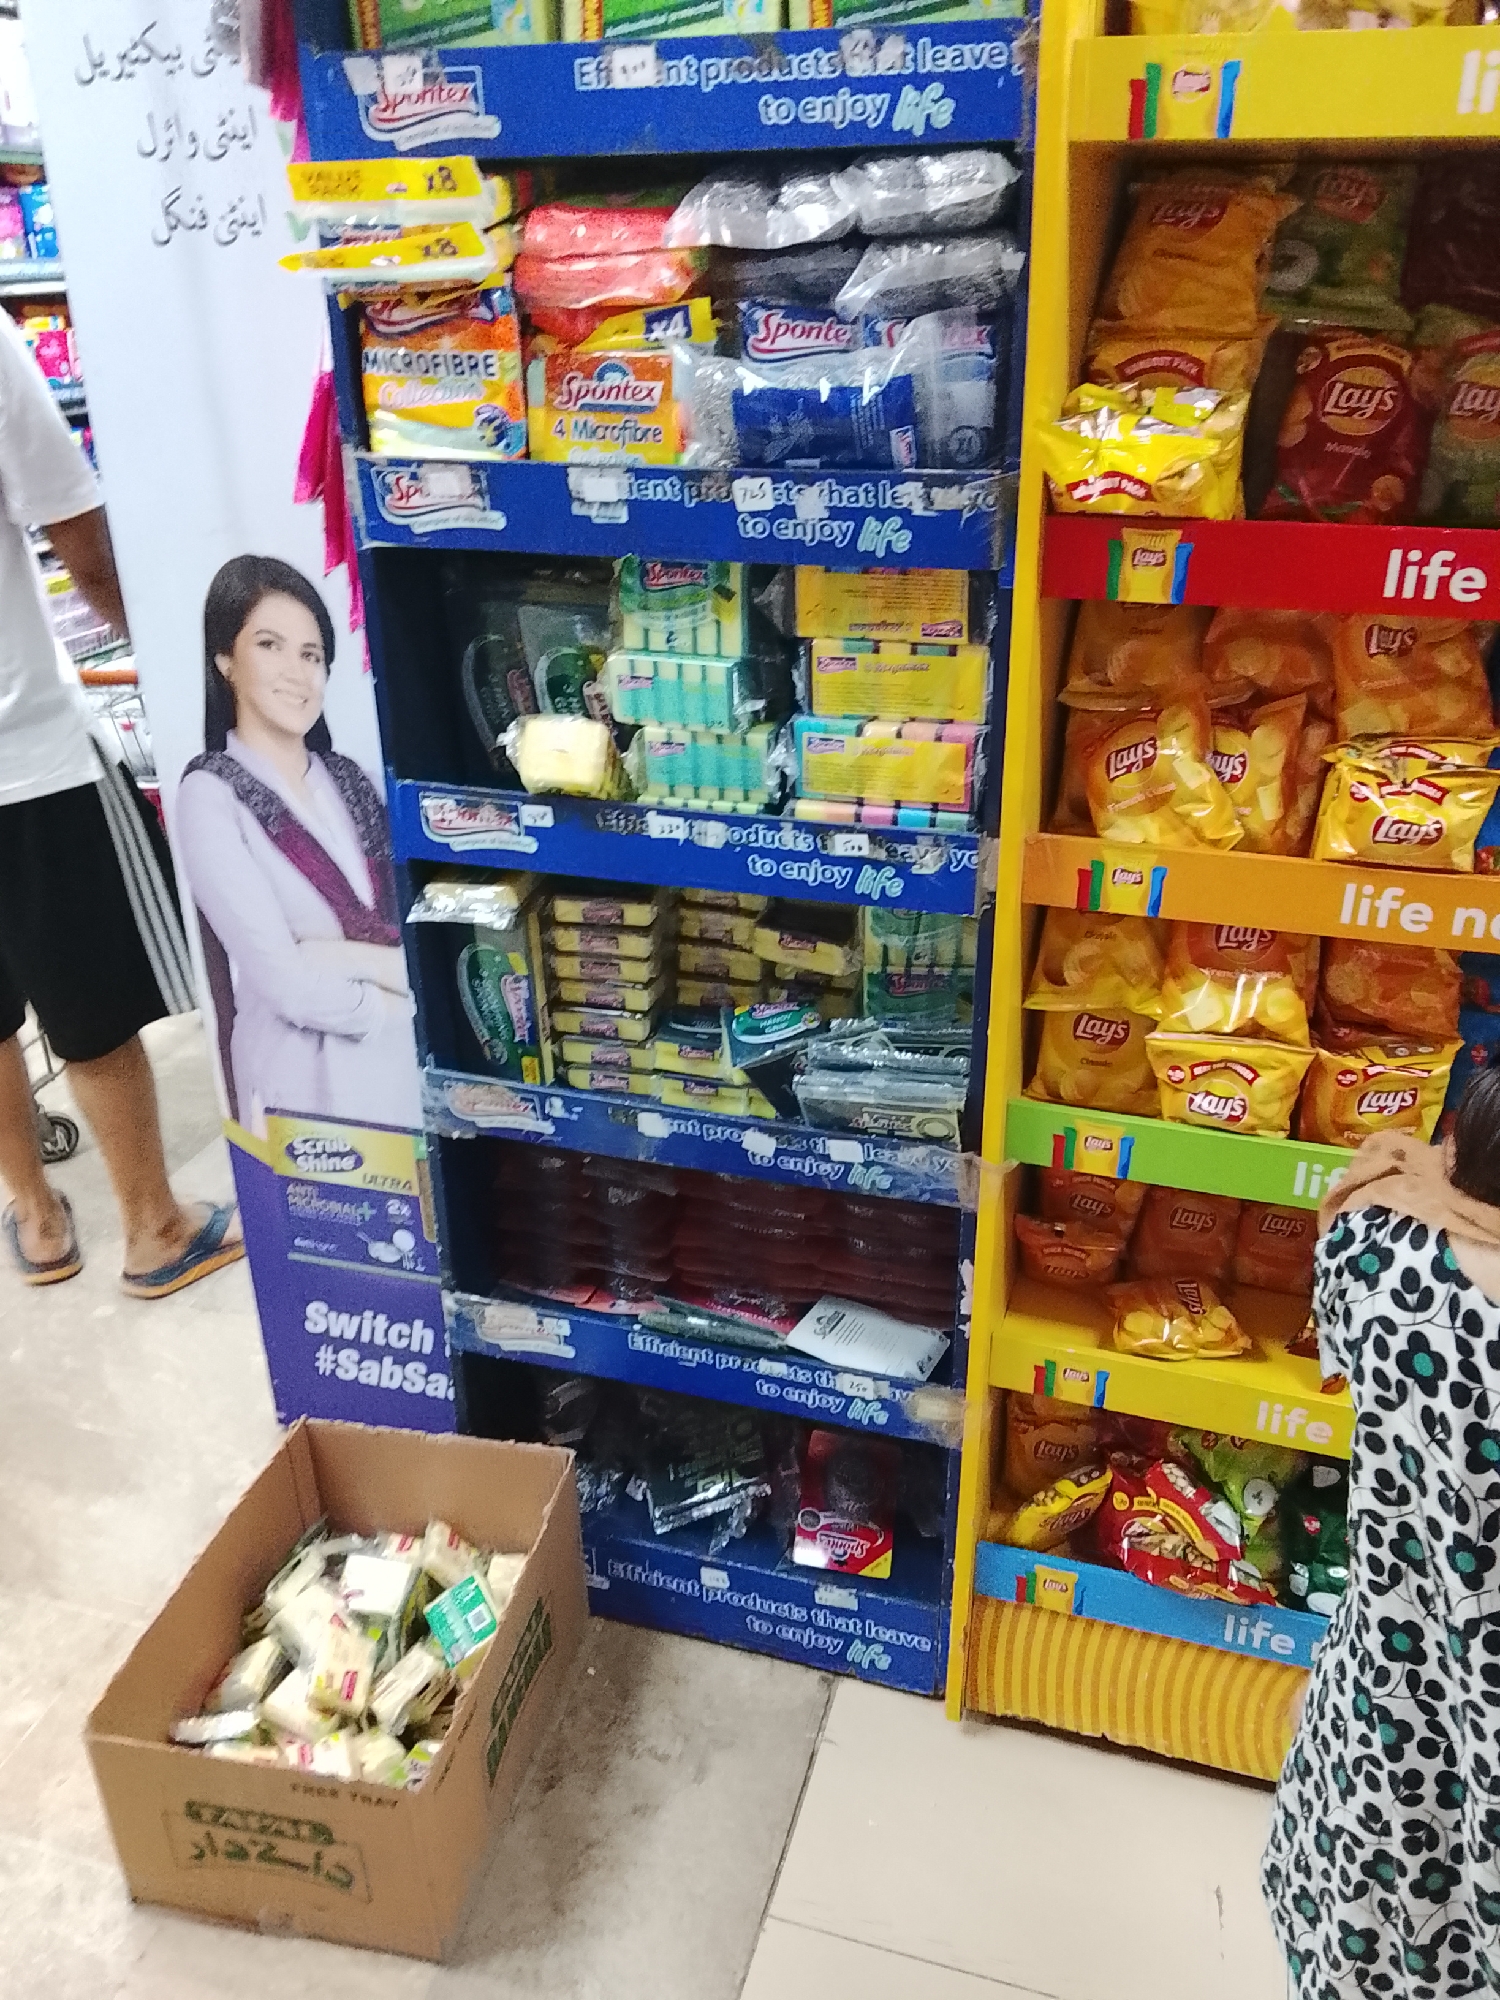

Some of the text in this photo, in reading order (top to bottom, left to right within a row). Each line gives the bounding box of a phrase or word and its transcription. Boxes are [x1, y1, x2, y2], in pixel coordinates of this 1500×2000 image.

[700, 46, 843, 93] products
[916, 36, 1009, 75] leave
[758, 81, 957, 137] to enjoy life
[757, 309, 850, 346] Sponte
[361, 348, 497, 379] MICROFIBRE
[556, 371, 661, 412] Spontex
[553, 417, 662, 451] 4 Microfibre
[736, 513, 913, 559] to enjoy life
[1383, 548, 1488, 604] life
[747, 854, 905, 900] to enjoy life
[1340, 883, 1434, 930] life
[295, 1153, 358, 1173] Shine
[748, 1149, 894, 1190] to enjoy life
[304, 1300, 435, 1357] Switch
[755, 1377, 889, 1426] to enjoy life
[1256, 1401, 1334, 1441] life
[702, 1585, 809, 1623] products
[811, 1607, 863, 1638] that
[864, 1619, 933, 1652] leave
[745, 1612, 893, 1671] to enjoy life
[1223, 1614, 1296, 1656] life
